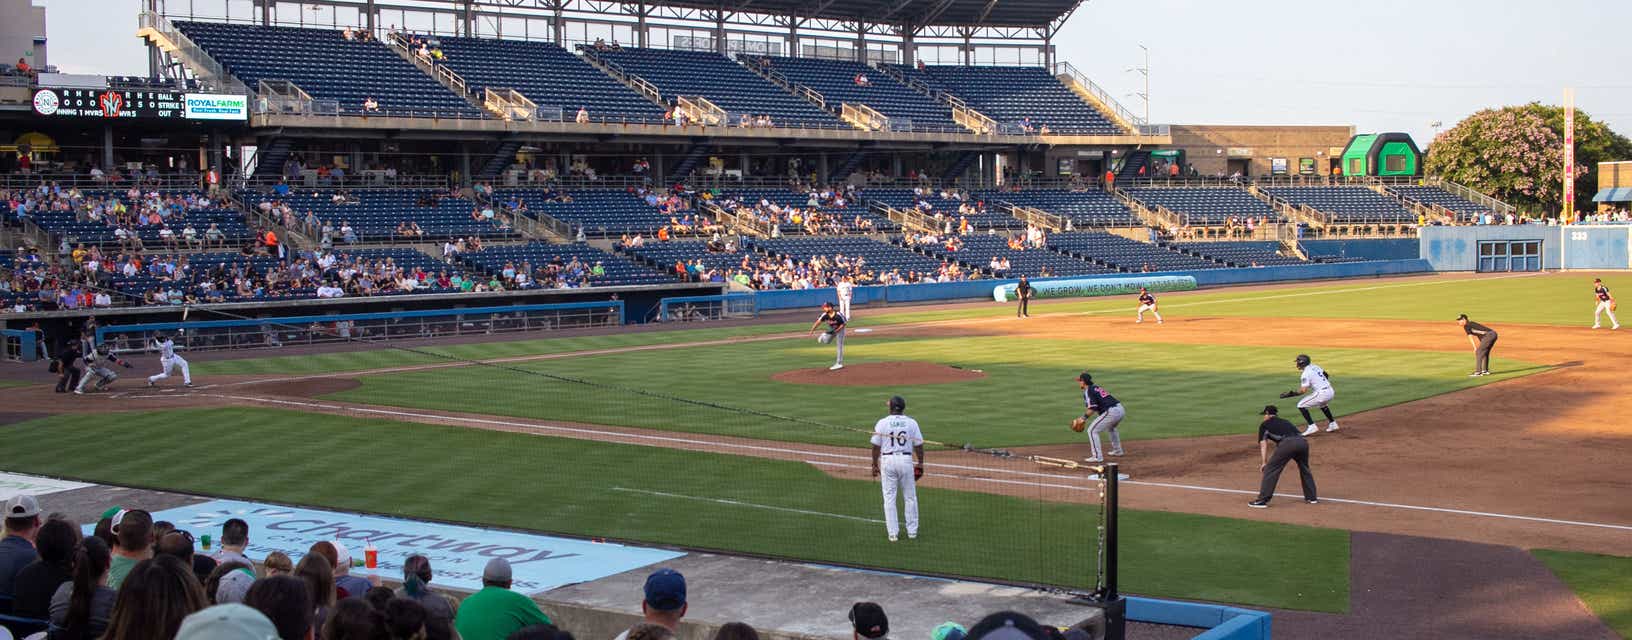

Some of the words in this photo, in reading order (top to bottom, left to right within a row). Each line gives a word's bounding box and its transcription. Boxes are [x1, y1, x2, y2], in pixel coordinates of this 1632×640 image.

[1571, 231, 1588, 240] 333
[889, 430, 907, 447] 16
[265, 519, 582, 565] Chartway
